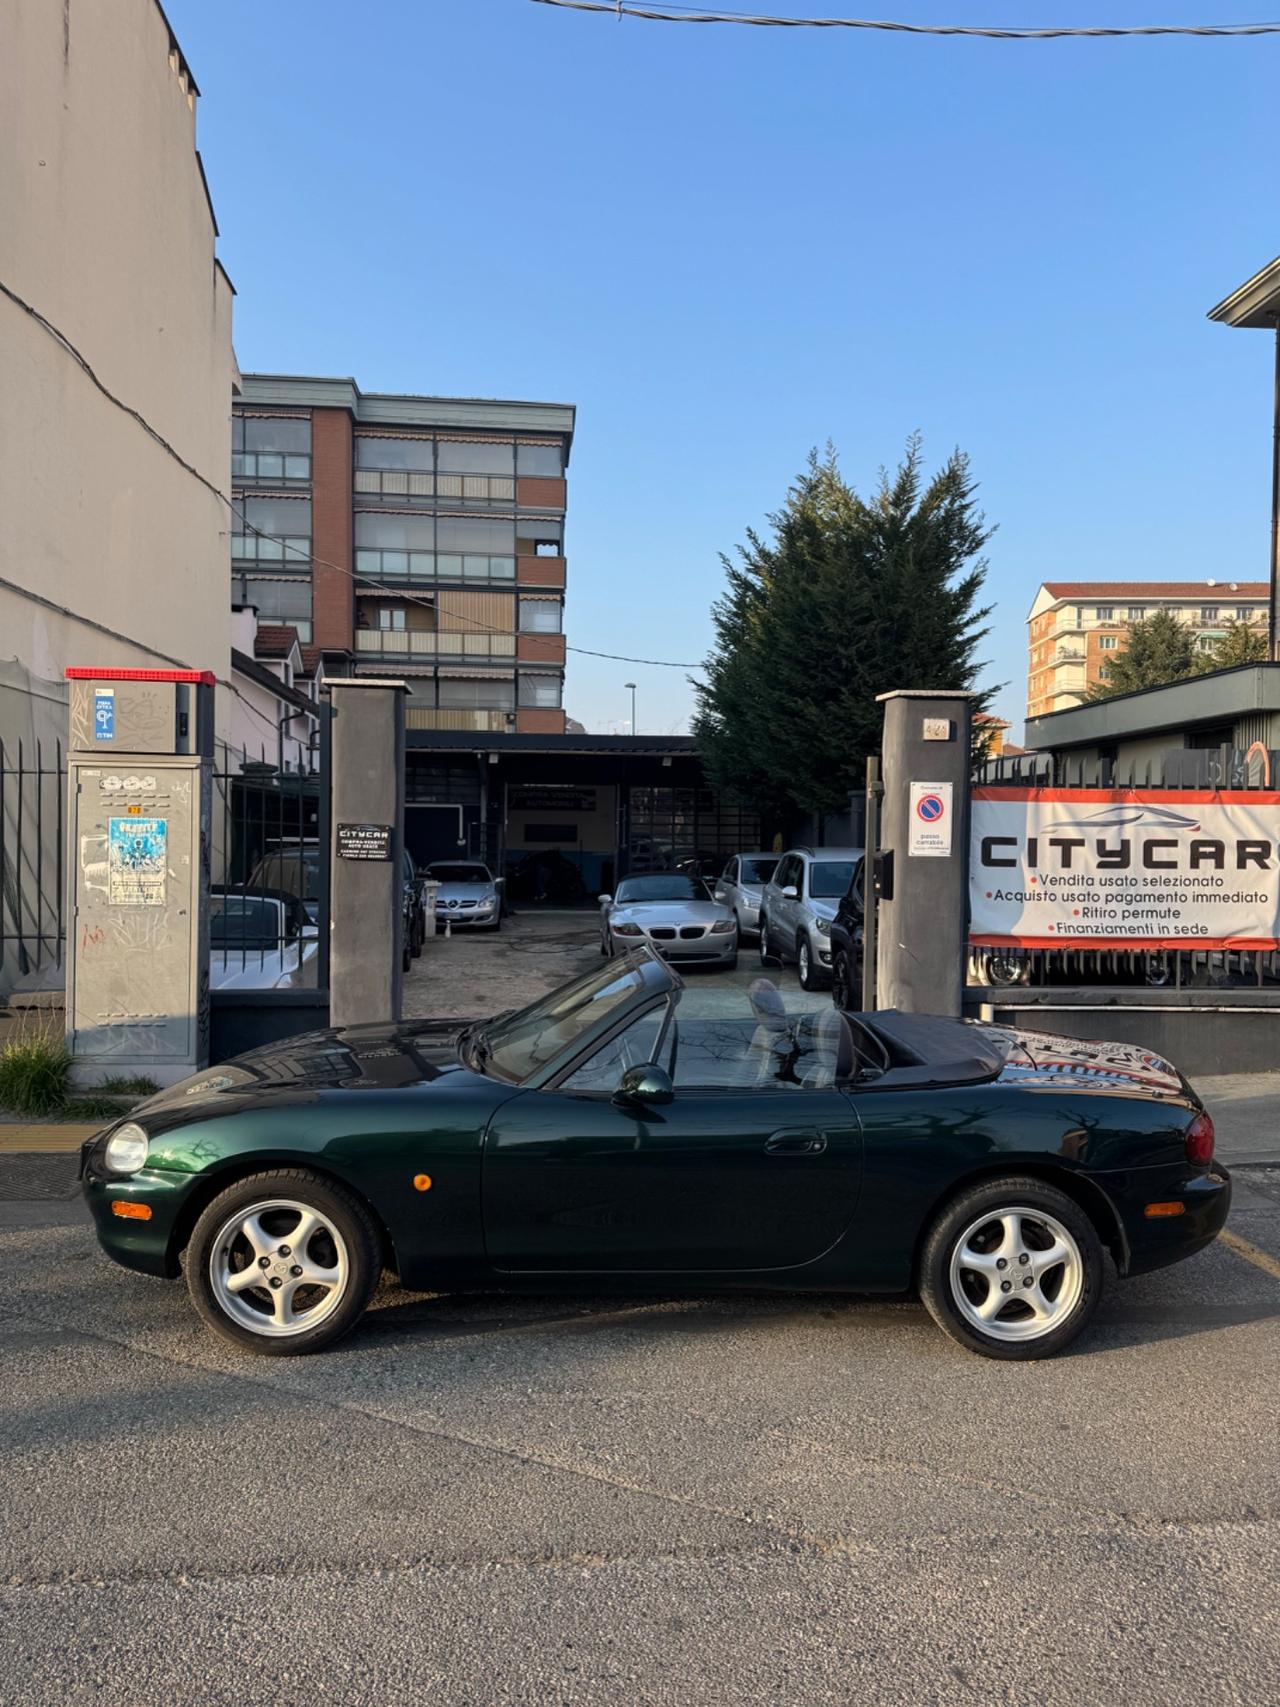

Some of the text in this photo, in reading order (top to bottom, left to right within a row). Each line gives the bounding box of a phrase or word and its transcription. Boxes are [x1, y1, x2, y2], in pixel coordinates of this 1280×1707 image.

[339, 830, 389, 838] CITYCAR
[981, 837, 1272, 870] CITYCAR
[1040, 874, 1224, 887] Vendita usato selezionato
[994, 889, 1268, 905] Acquisto usato pagamento immediato
[1082, 906, 1181, 921] Ritiro permute
[1057, 922, 1208, 935] Finanziamenti in sede
